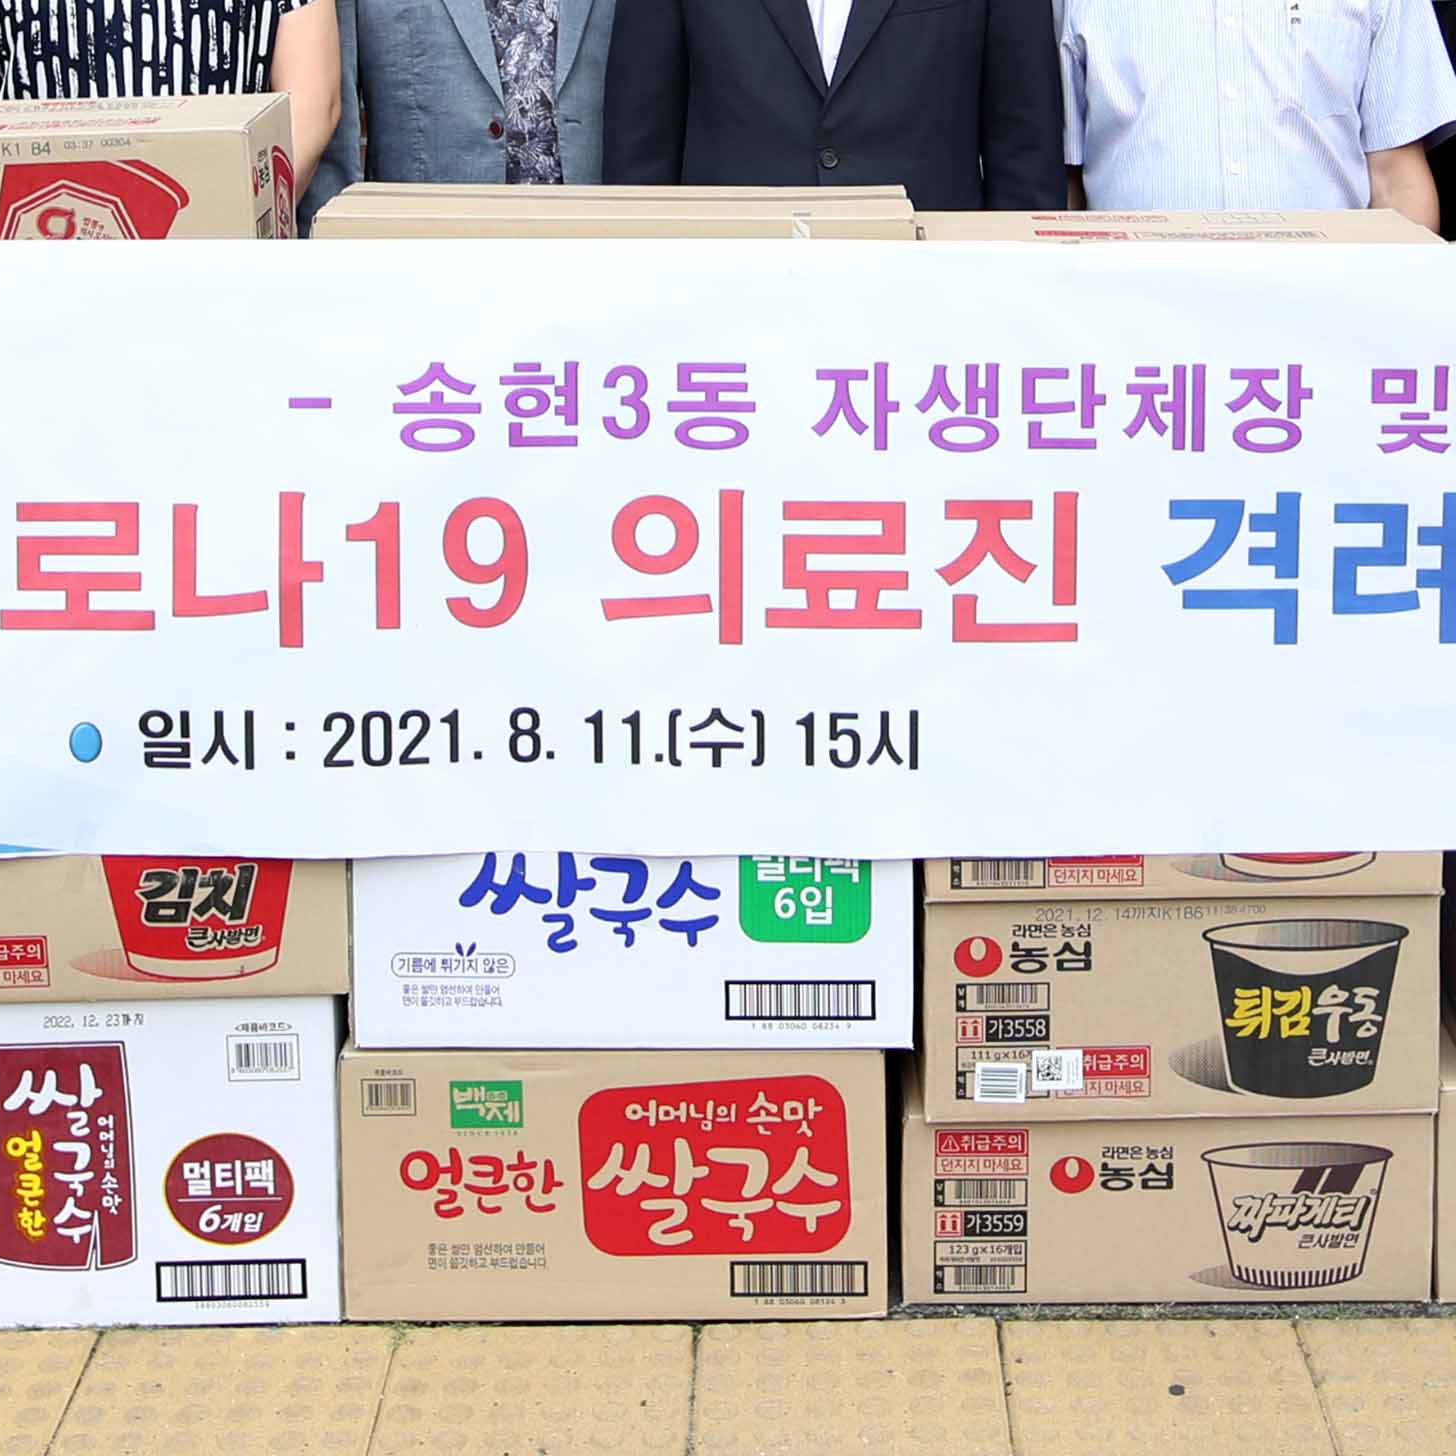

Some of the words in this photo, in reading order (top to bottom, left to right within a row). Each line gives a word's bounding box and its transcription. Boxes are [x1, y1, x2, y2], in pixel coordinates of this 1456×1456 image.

[392, 359, 759, 453] 송현3동
[810, 360, 1313, 454] 자생단체장
[1372, 363, 1452, 454] 및
[600, 489, 1079, 646] 의료진
[139, 712, 258, 772] 일시
[322, 710, 484, 770] 2021.
[509, 710, 556, 766] 8.
[798, 706, 920, 773] 15시
[138, 862, 258, 925] 김치
[459, 852, 721, 953] 쌀국수
[774, 887, 833, 925] 6입
[398, 958, 437, 974] 기름에
[441, 957, 479, 974] 튀기지
[483, 957, 509, 974] 않은
[1010, 940, 1092, 973] 농심
[988, 1018, 1046, 1039] 가3558
[625, 1097, 738, 1131] 어머님의
[746, 1091, 822, 1136] 손맛
[4, 1063, 103, 1244] 쌀국수
[960, 1134, 1021, 1151] 취급주의
[1102, 1146, 1143, 1160] 라면은
[183, 1161, 275, 1194] 멀티팩
[400, 1147, 564, 1218] 얼큰한
[588, 1137, 842, 1245] 쌀국수
[1099, 1162, 1174, 1191] 농심
[199, 1205, 263, 1233] 6개입
[966, 1214, 1024, 1233] 가3559
[1227, 1191, 1371, 1242] 짜파게티
[1298, 1233, 1359, 1249] 큰사발면
